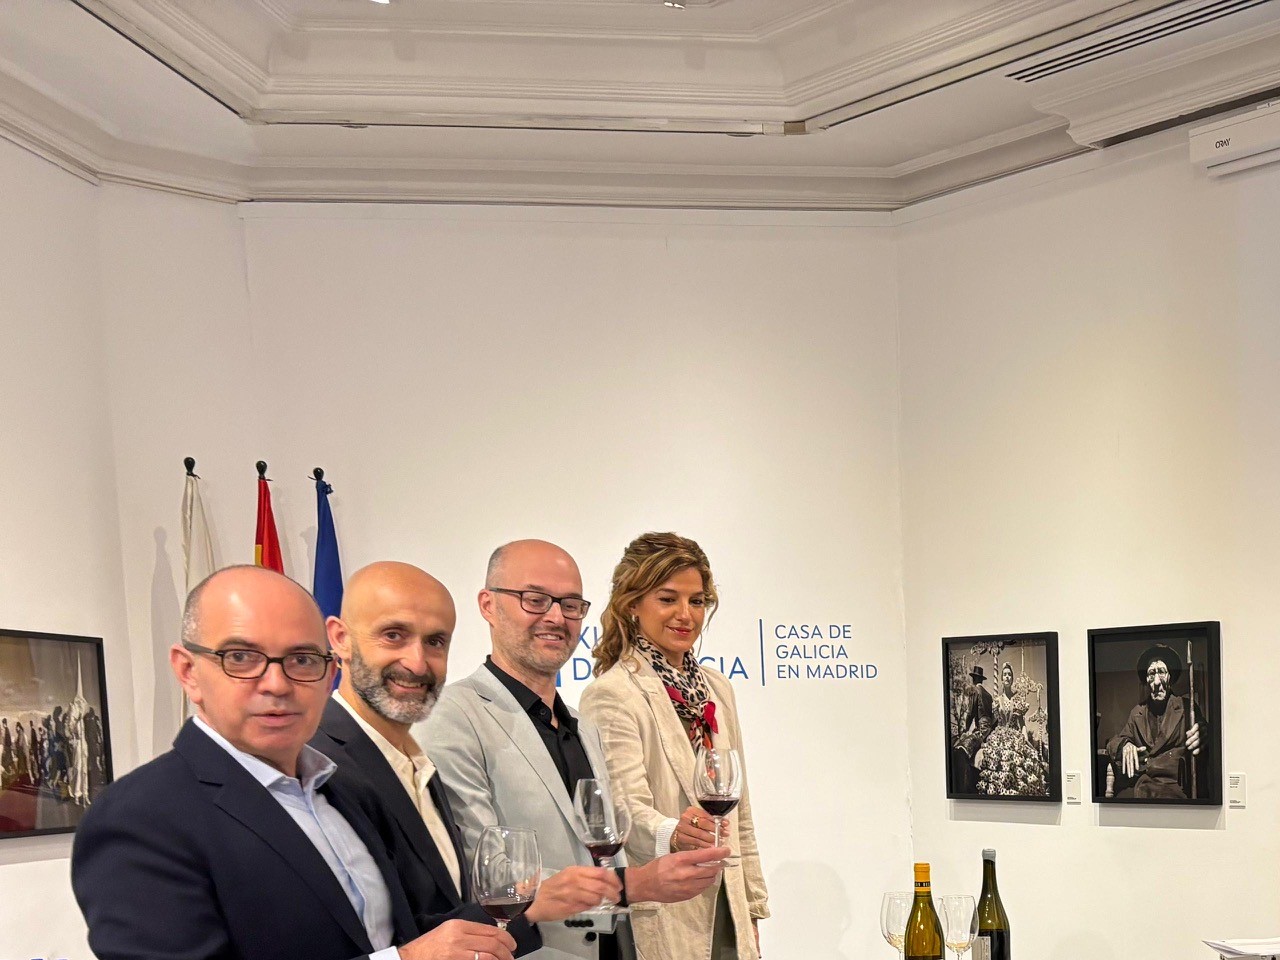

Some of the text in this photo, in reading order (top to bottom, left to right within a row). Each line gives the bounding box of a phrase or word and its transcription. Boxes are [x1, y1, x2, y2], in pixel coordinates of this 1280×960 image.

[774, 624, 852, 639] CASA DE
[776, 645, 848, 659] GALICIA
[777, 664, 878, 679] EN MADRID
